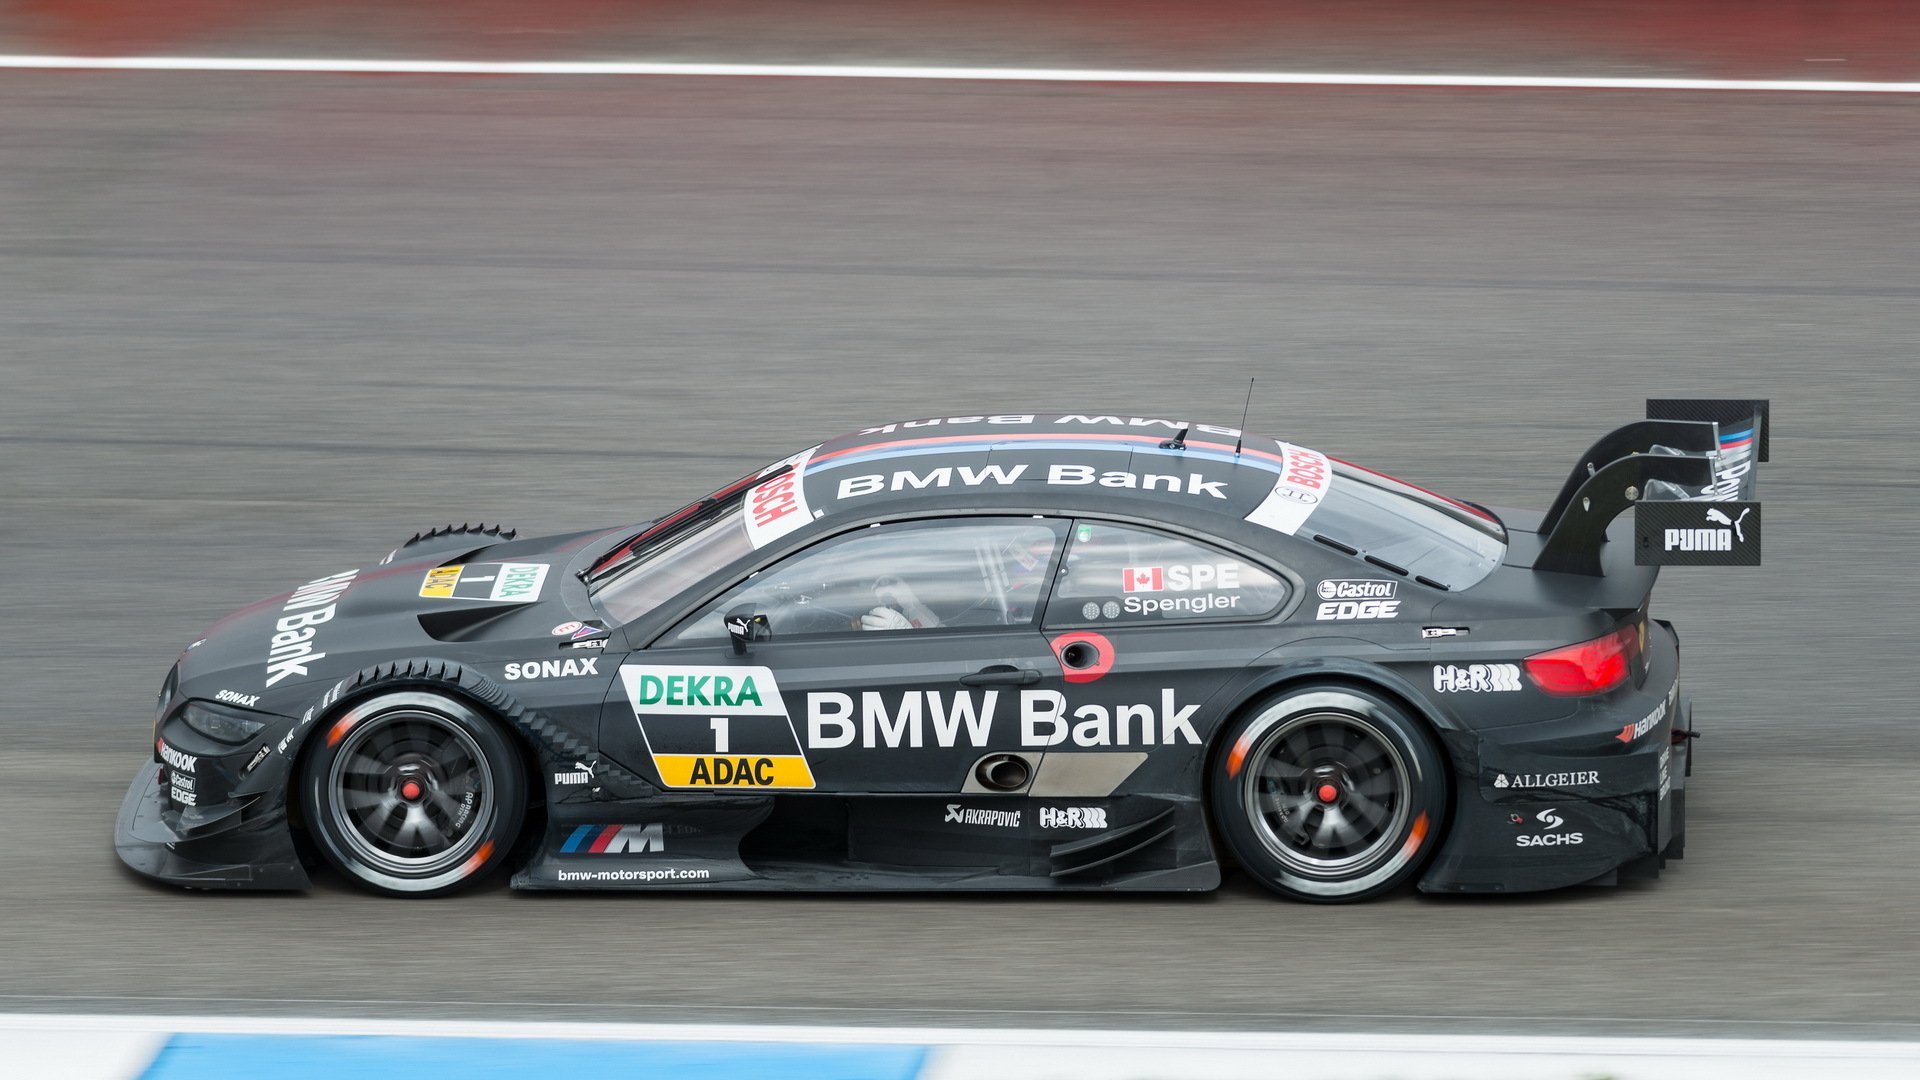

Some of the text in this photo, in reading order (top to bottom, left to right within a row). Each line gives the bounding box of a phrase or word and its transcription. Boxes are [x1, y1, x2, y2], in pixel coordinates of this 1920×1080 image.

[859, 414, 1242, 438] BMW Bank
[1286, 448, 1325, 489] BOSCH
[837, 464, 1228, 500] BMW Bank
[753, 464, 800, 528] OSCH
[1665, 528, 1731, 551] PUMA
[460, 575, 496, 583] 1
[500, 566, 541, 599] DEKRA
[1168, 563, 1241, 591] SPE
[1336, 582, 1392, 598] Castrol
[1123, 593, 1241, 616] Spengler
[1316, 601, 1402, 620] EDGE
[727, 622, 745, 635] PUMA
[265, 603, 338, 688] Bank
[505, 658, 598, 680] SONAX
[215, 690, 260, 707] SONAX
[640, 676, 762, 707] DEKRA
[807, 688, 1201, 748] BMW Bank
[709, 717, 729, 752] 1
[555, 772, 590, 785] PUMA
[690, 757, 774, 786] ADAC
[1511, 770, 1600, 788] ALLGEIER
[171, 786, 198, 807] EDGE
[1516, 832, 1583, 847] SACHS
[558, 869, 710, 882] bmw-motorsport.com
